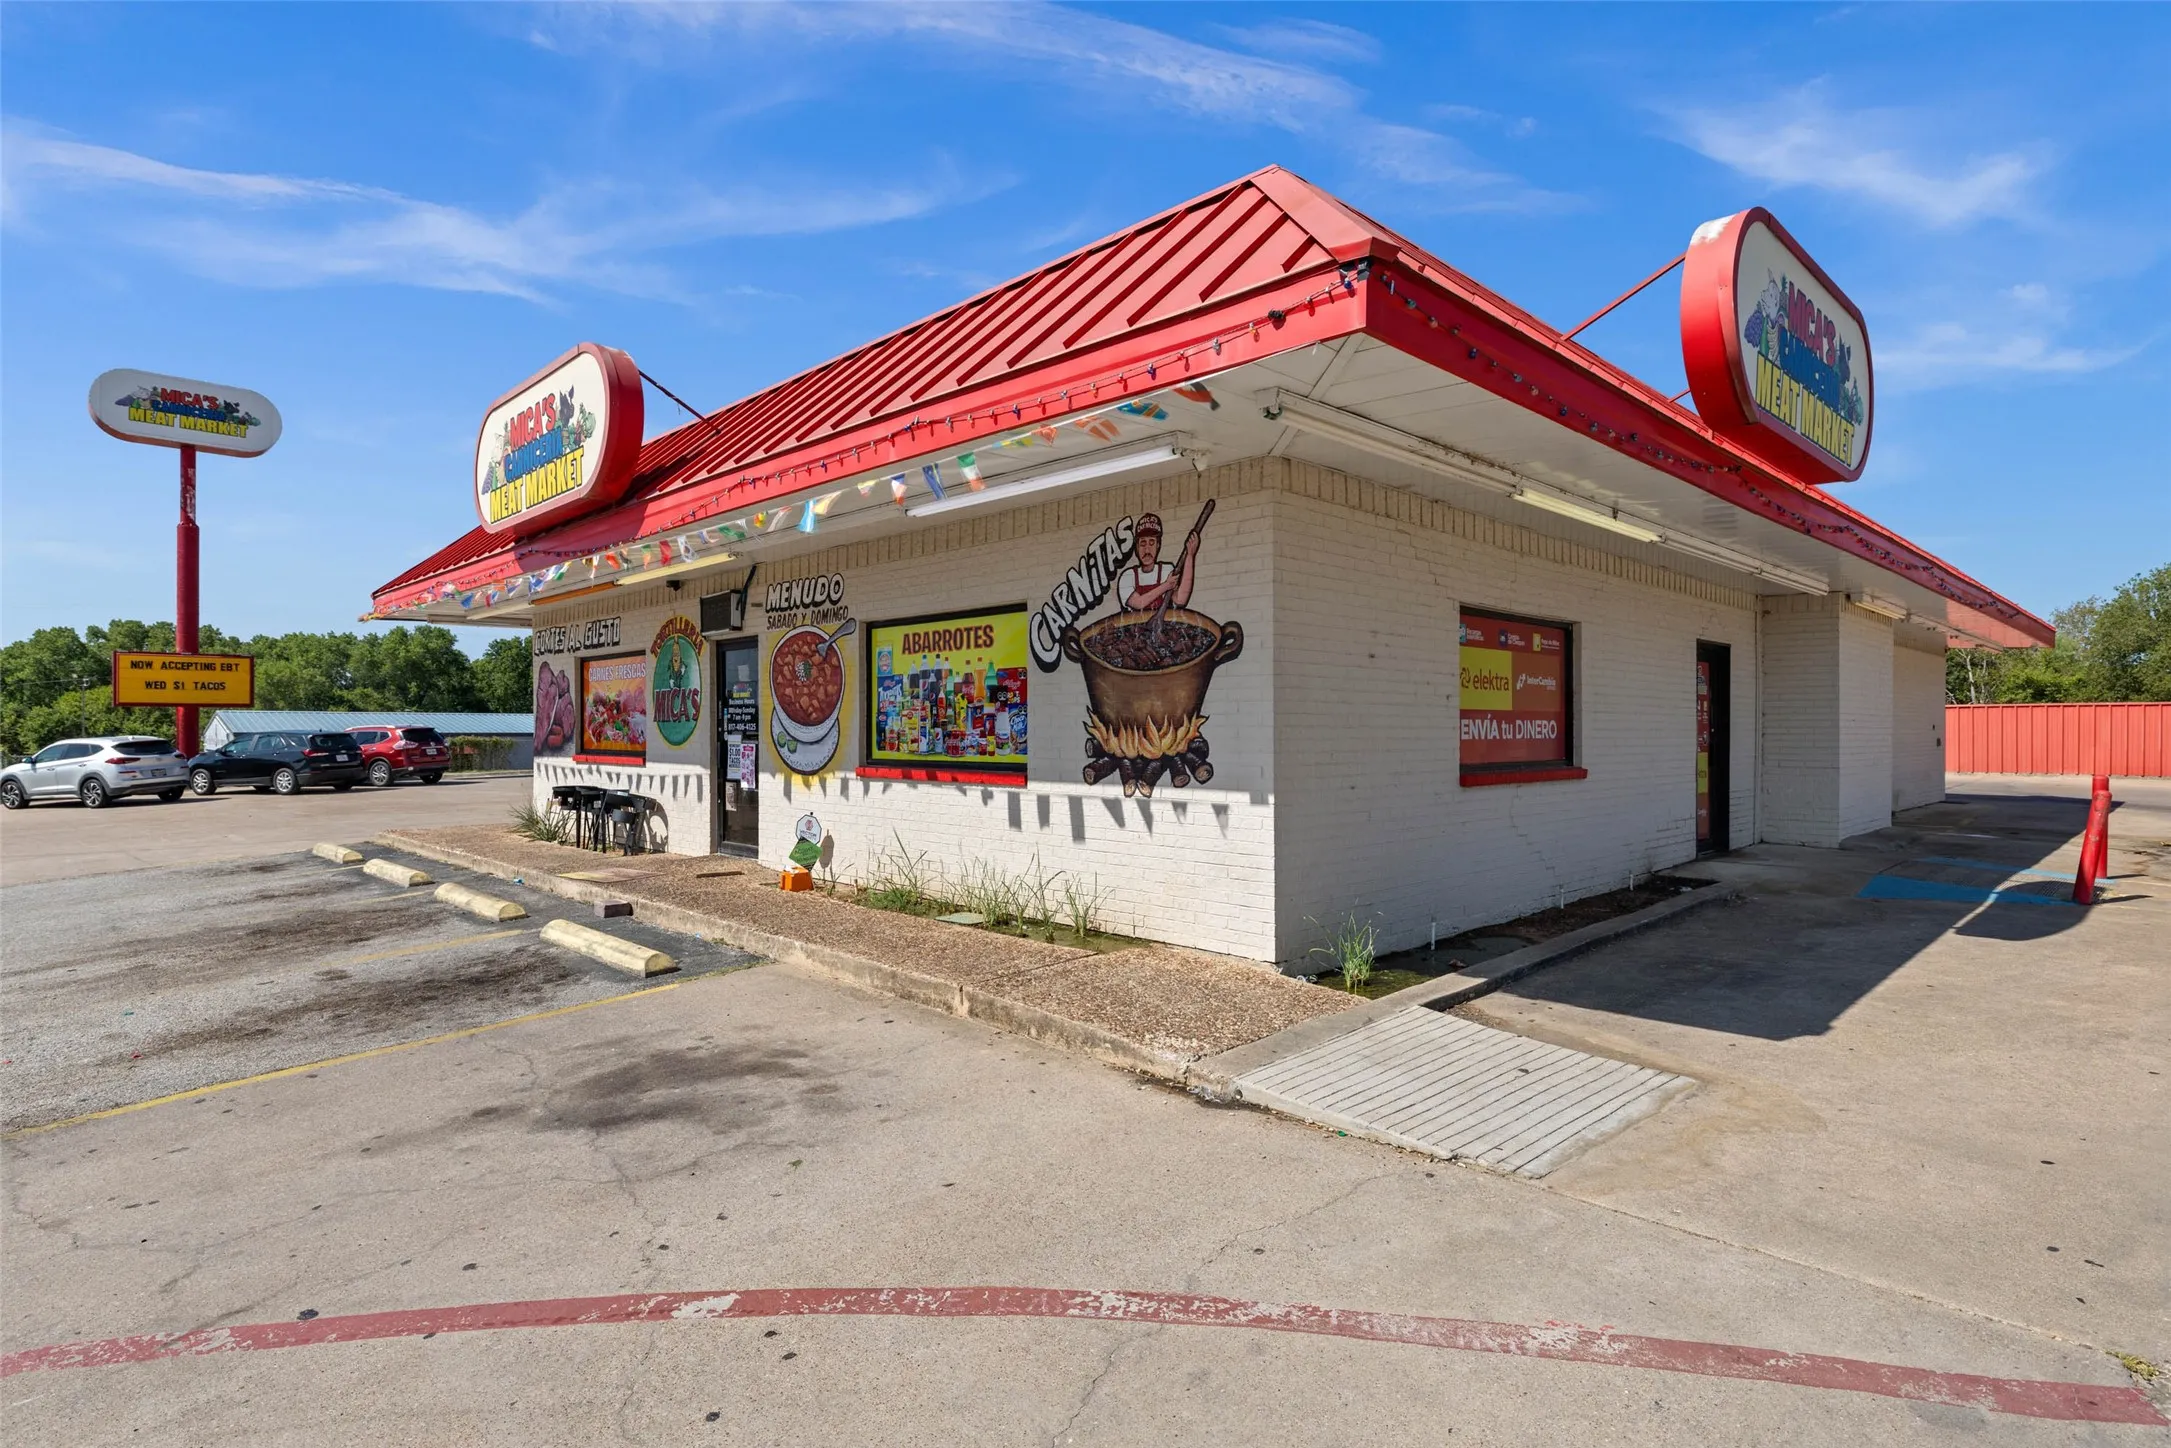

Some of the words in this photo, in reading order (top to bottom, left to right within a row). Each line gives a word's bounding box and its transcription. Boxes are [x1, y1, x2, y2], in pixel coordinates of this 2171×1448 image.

[1788, 280, 1836, 368] MICA'S
[161, 388, 219, 410] MICA'S
[1756, 350, 1800, 432] MEAT
[1801, 385, 1855, 467] MARKET
[128, 406, 176, 427] MEAT
[180, 415, 248, 438] MARKET
[509, 393, 556, 451] MICA'S
[490, 478, 524, 524] MEAT
[525, 446, 584, 509] MARKET
[765, 572, 845, 613] MENUDO
[767, 612, 797, 630] SABADO
[801, 612, 807, 625] Y
[811, 605, 849, 626] DOMINGO
[534, 627, 566, 657] CORTES
[567, 624, 583, 654] AL
[583, 616, 621, 650] GUSTO
[902, 624, 994, 655] ABARROTES
[130, 660, 153, 670] NOW
[161, 661, 216, 671] ACCEPTING
[221, 663, 240, 672] EBT
[589, 665, 614, 683] CARNES
[615, 662, 646, 680] FRESCAS
[1473, 669, 1509, 692] elektra
[145, 681, 166, 690] WED
[194, 681, 226, 690] TACOS
[653, 687, 700, 723] MICA'S
[1460, 713, 1500, 740] ENVÍA
[1502, 721, 1513, 739] tu
[1515, 719, 1557, 739] DINERO
